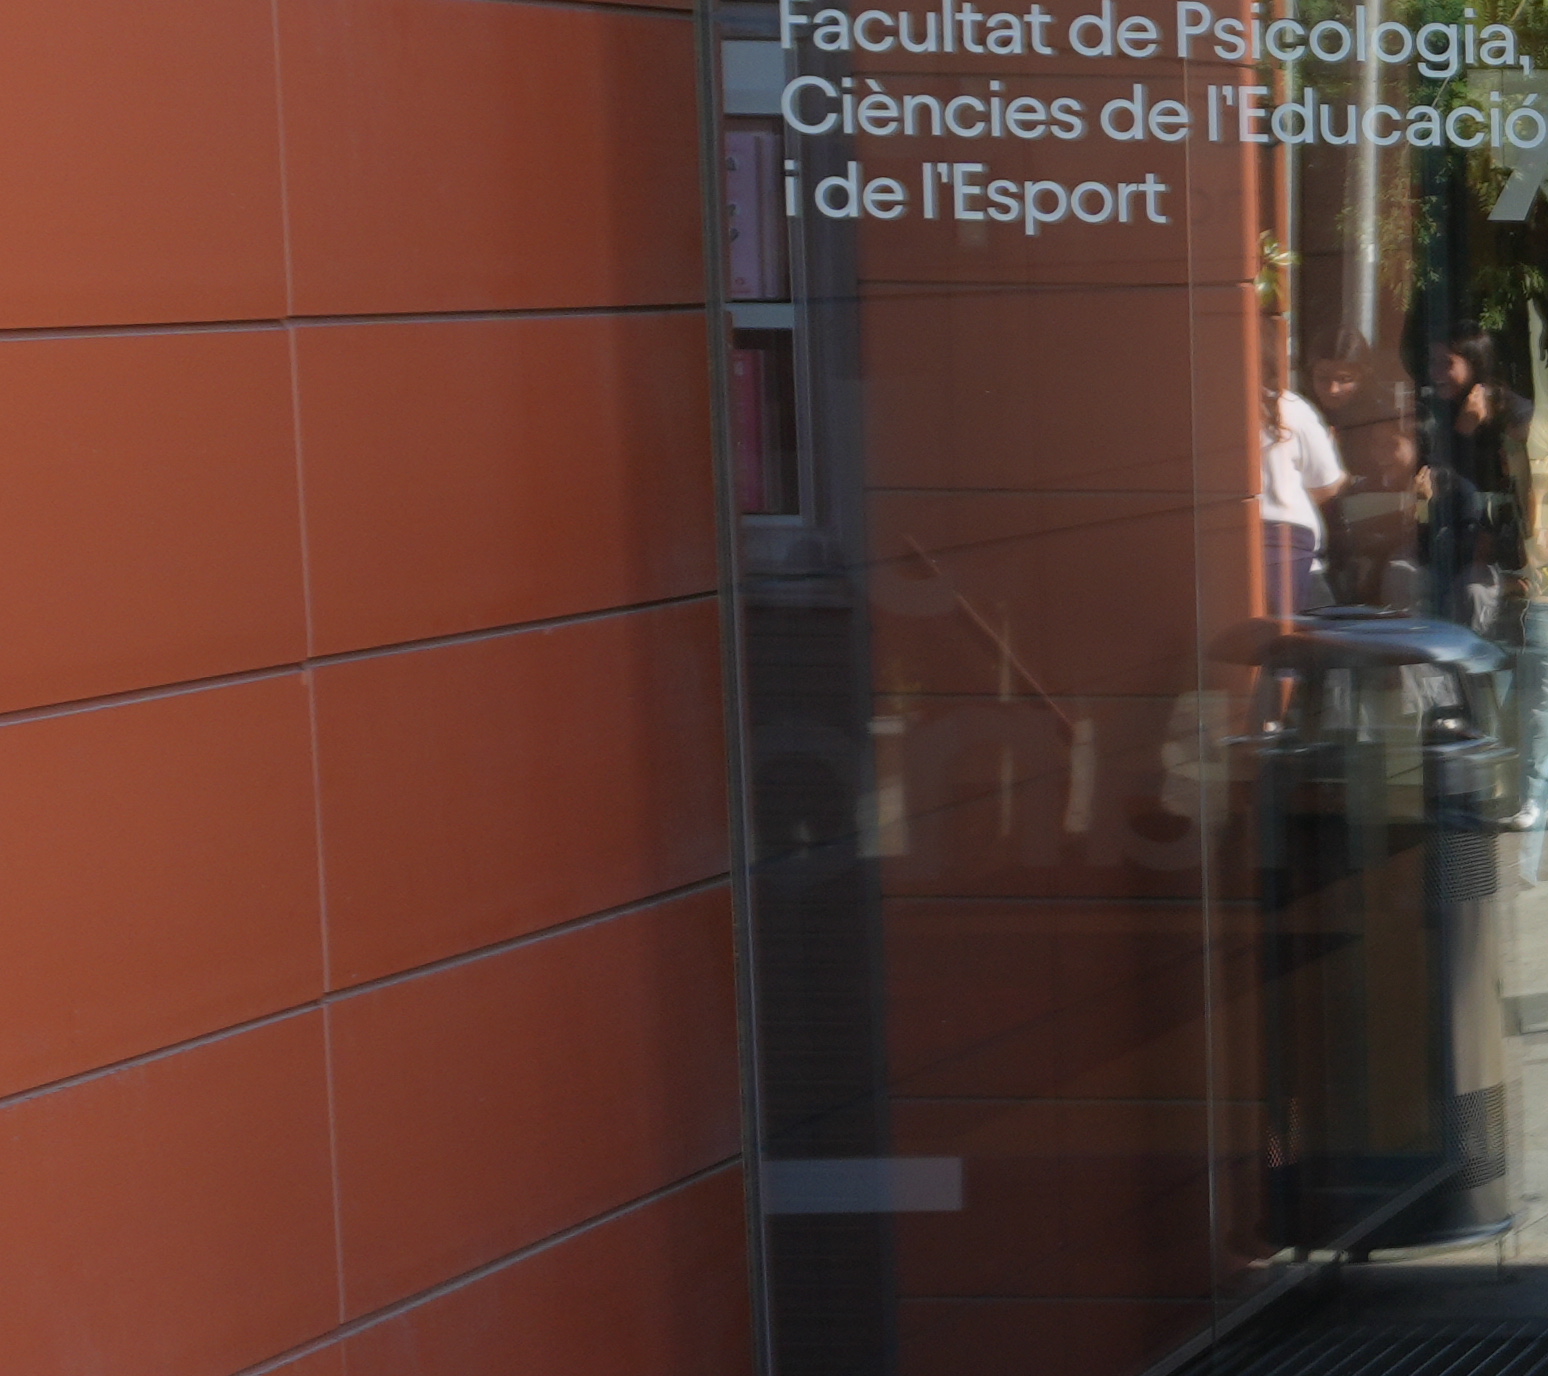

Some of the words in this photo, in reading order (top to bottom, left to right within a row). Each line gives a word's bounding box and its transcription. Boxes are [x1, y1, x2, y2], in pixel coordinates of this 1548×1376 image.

[1069, 0, 1158, 58] de
[1176, 0, 1533, 79] Psicologia,
[780, 74, 1082, 143] Ciències
[1101, 82, 1190, 143] de
[1207, 83, 1548, 151] l'Educació
[784, 159, 798, 217] i
[814, 161, 905, 220] de
[922, 162, 1168, 235] l'Esport
